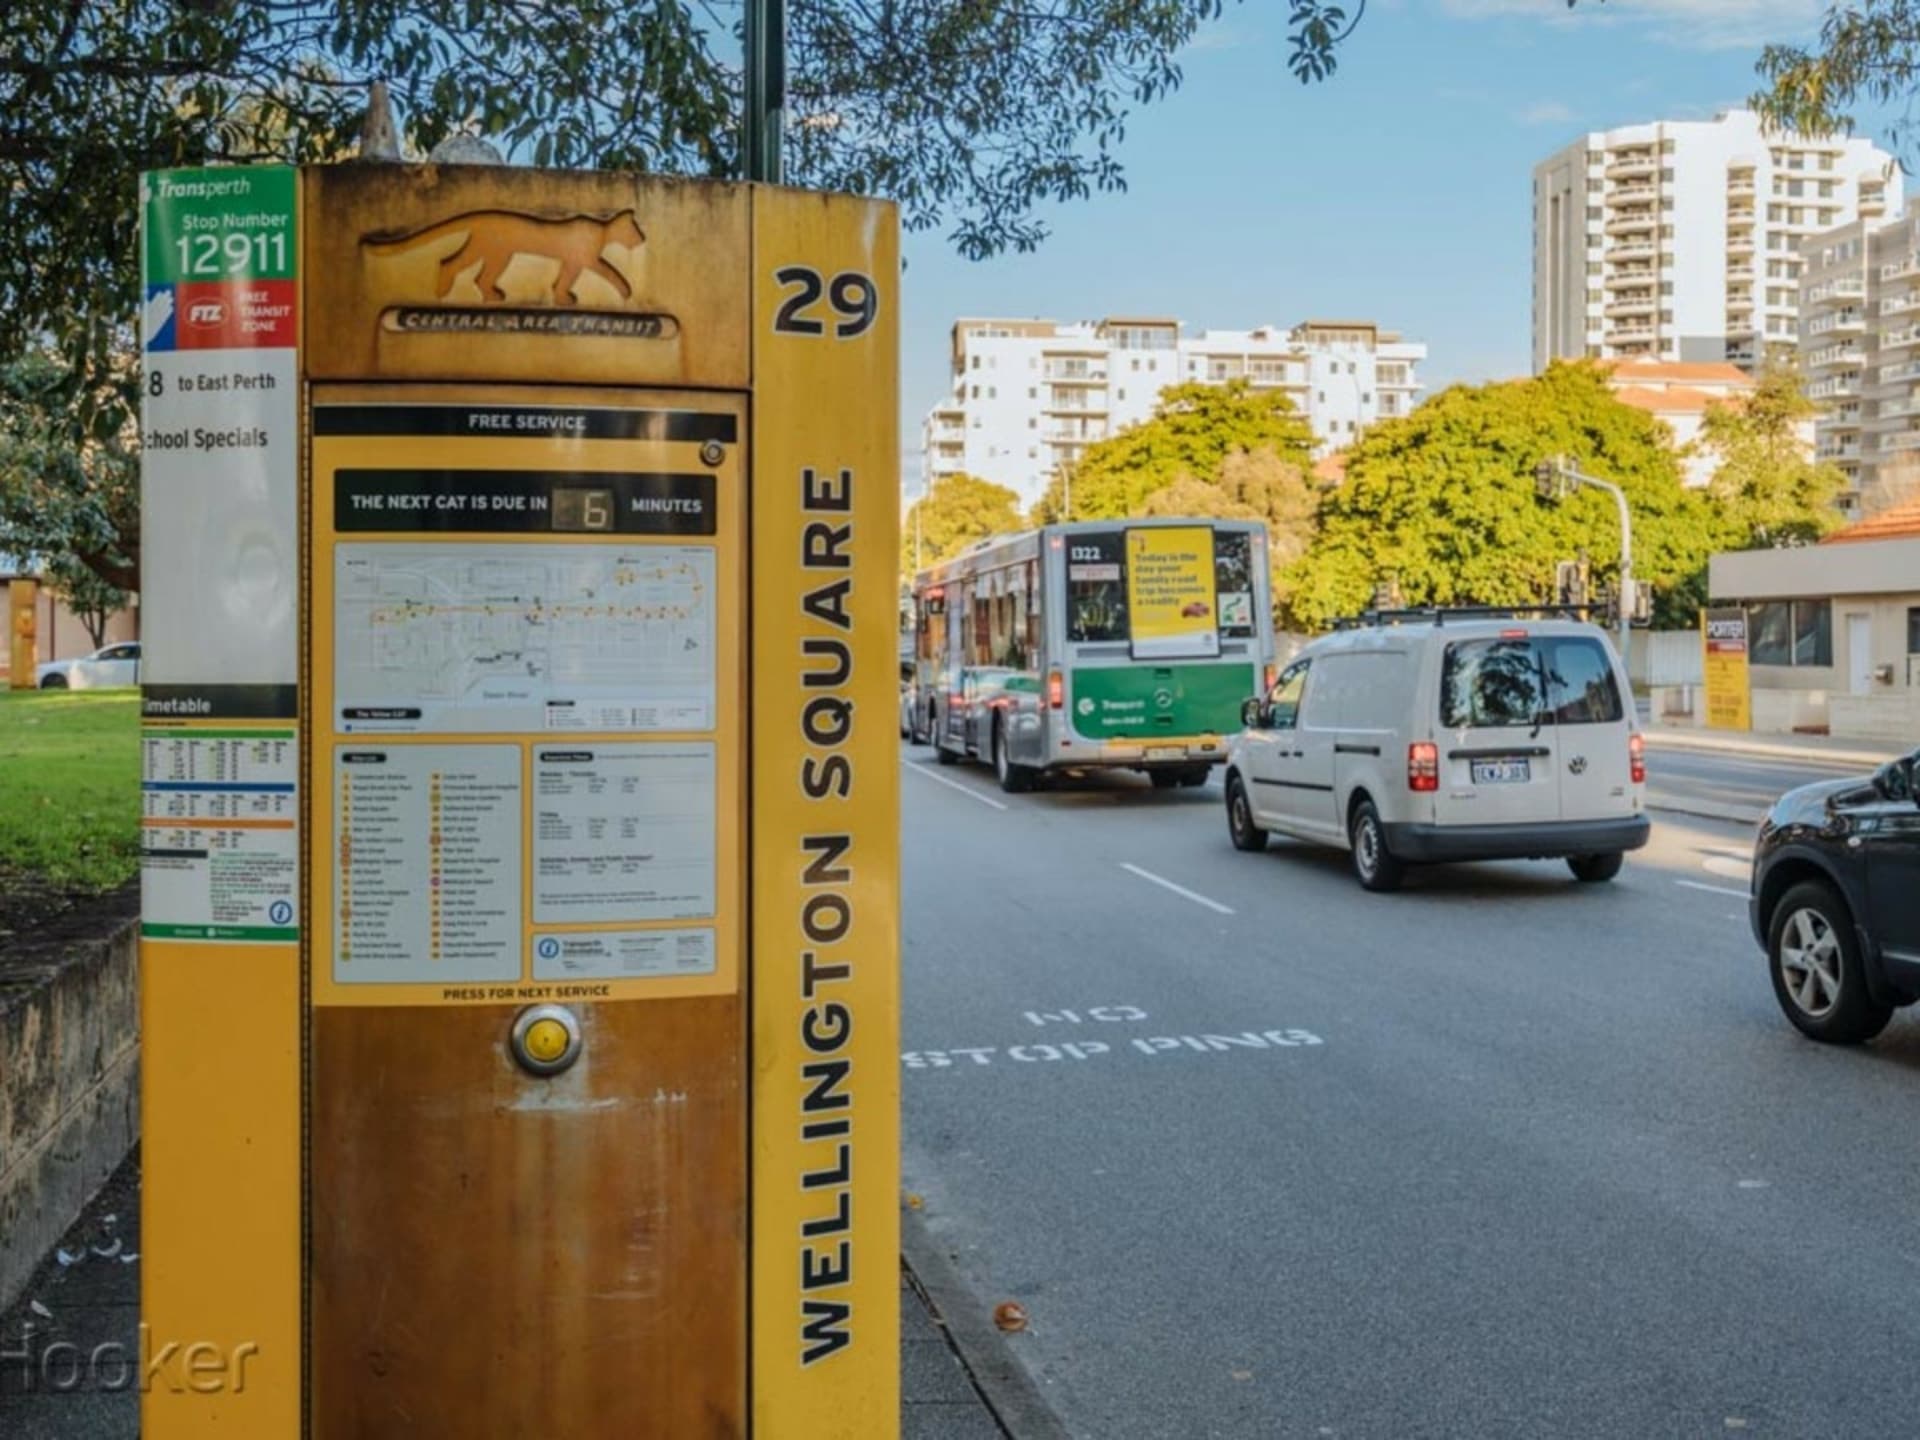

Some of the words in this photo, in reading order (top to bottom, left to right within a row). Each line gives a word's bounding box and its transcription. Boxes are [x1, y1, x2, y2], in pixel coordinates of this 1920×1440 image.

[157, 177, 251, 200] Transperth
[182, 213, 220, 231] Stop
[223, 211, 289, 227] Number
[176, 232, 286, 275] 12911
[241, 304, 292, 318] TRANSIT
[774, 266, 878, 338] 29
[190, 304, 222, 322] FTZ
[241, 320, 276, 333] ZONE
[404, 312, 495, 330] CENTRAL
[504, 313, 560, 331] AREA
[570, 315, 656, 336] TRANSIT
[178, 375, 194, 392] to
[197, 373, 229, 391] East
[233, 372, 276, 390] Perth
[468, 414, 512, 429] FREE
[515, 415, 587, 430] SERVICE
[193, 427, 269, 452] Specials
[351, 495, 384, 510] THE
[387, 495, 431, 510] NEXT
[434, 495, 466, 510] CAT
[471, 496, 488, 510] IS
[492, 496, 526, 510] DUE
[530, 497, 548, 511] IN
[583, 492, 607, 528] 6
[631, 498, 703, 514] MINUTES
[1071, 546, 1101, 561] 1322
[801, 468, 854, 799] SQUARE
[443, 988, 486, 1000] PRESS
[489, 988, 513, 999] FOR
[518, 987, 552, 999] NEXT
[555, 985, 610, 998] SERVICE
[1022, 1004, 1148, 1027] NO
[801, 834, 852, 1366] WELLINGTON
